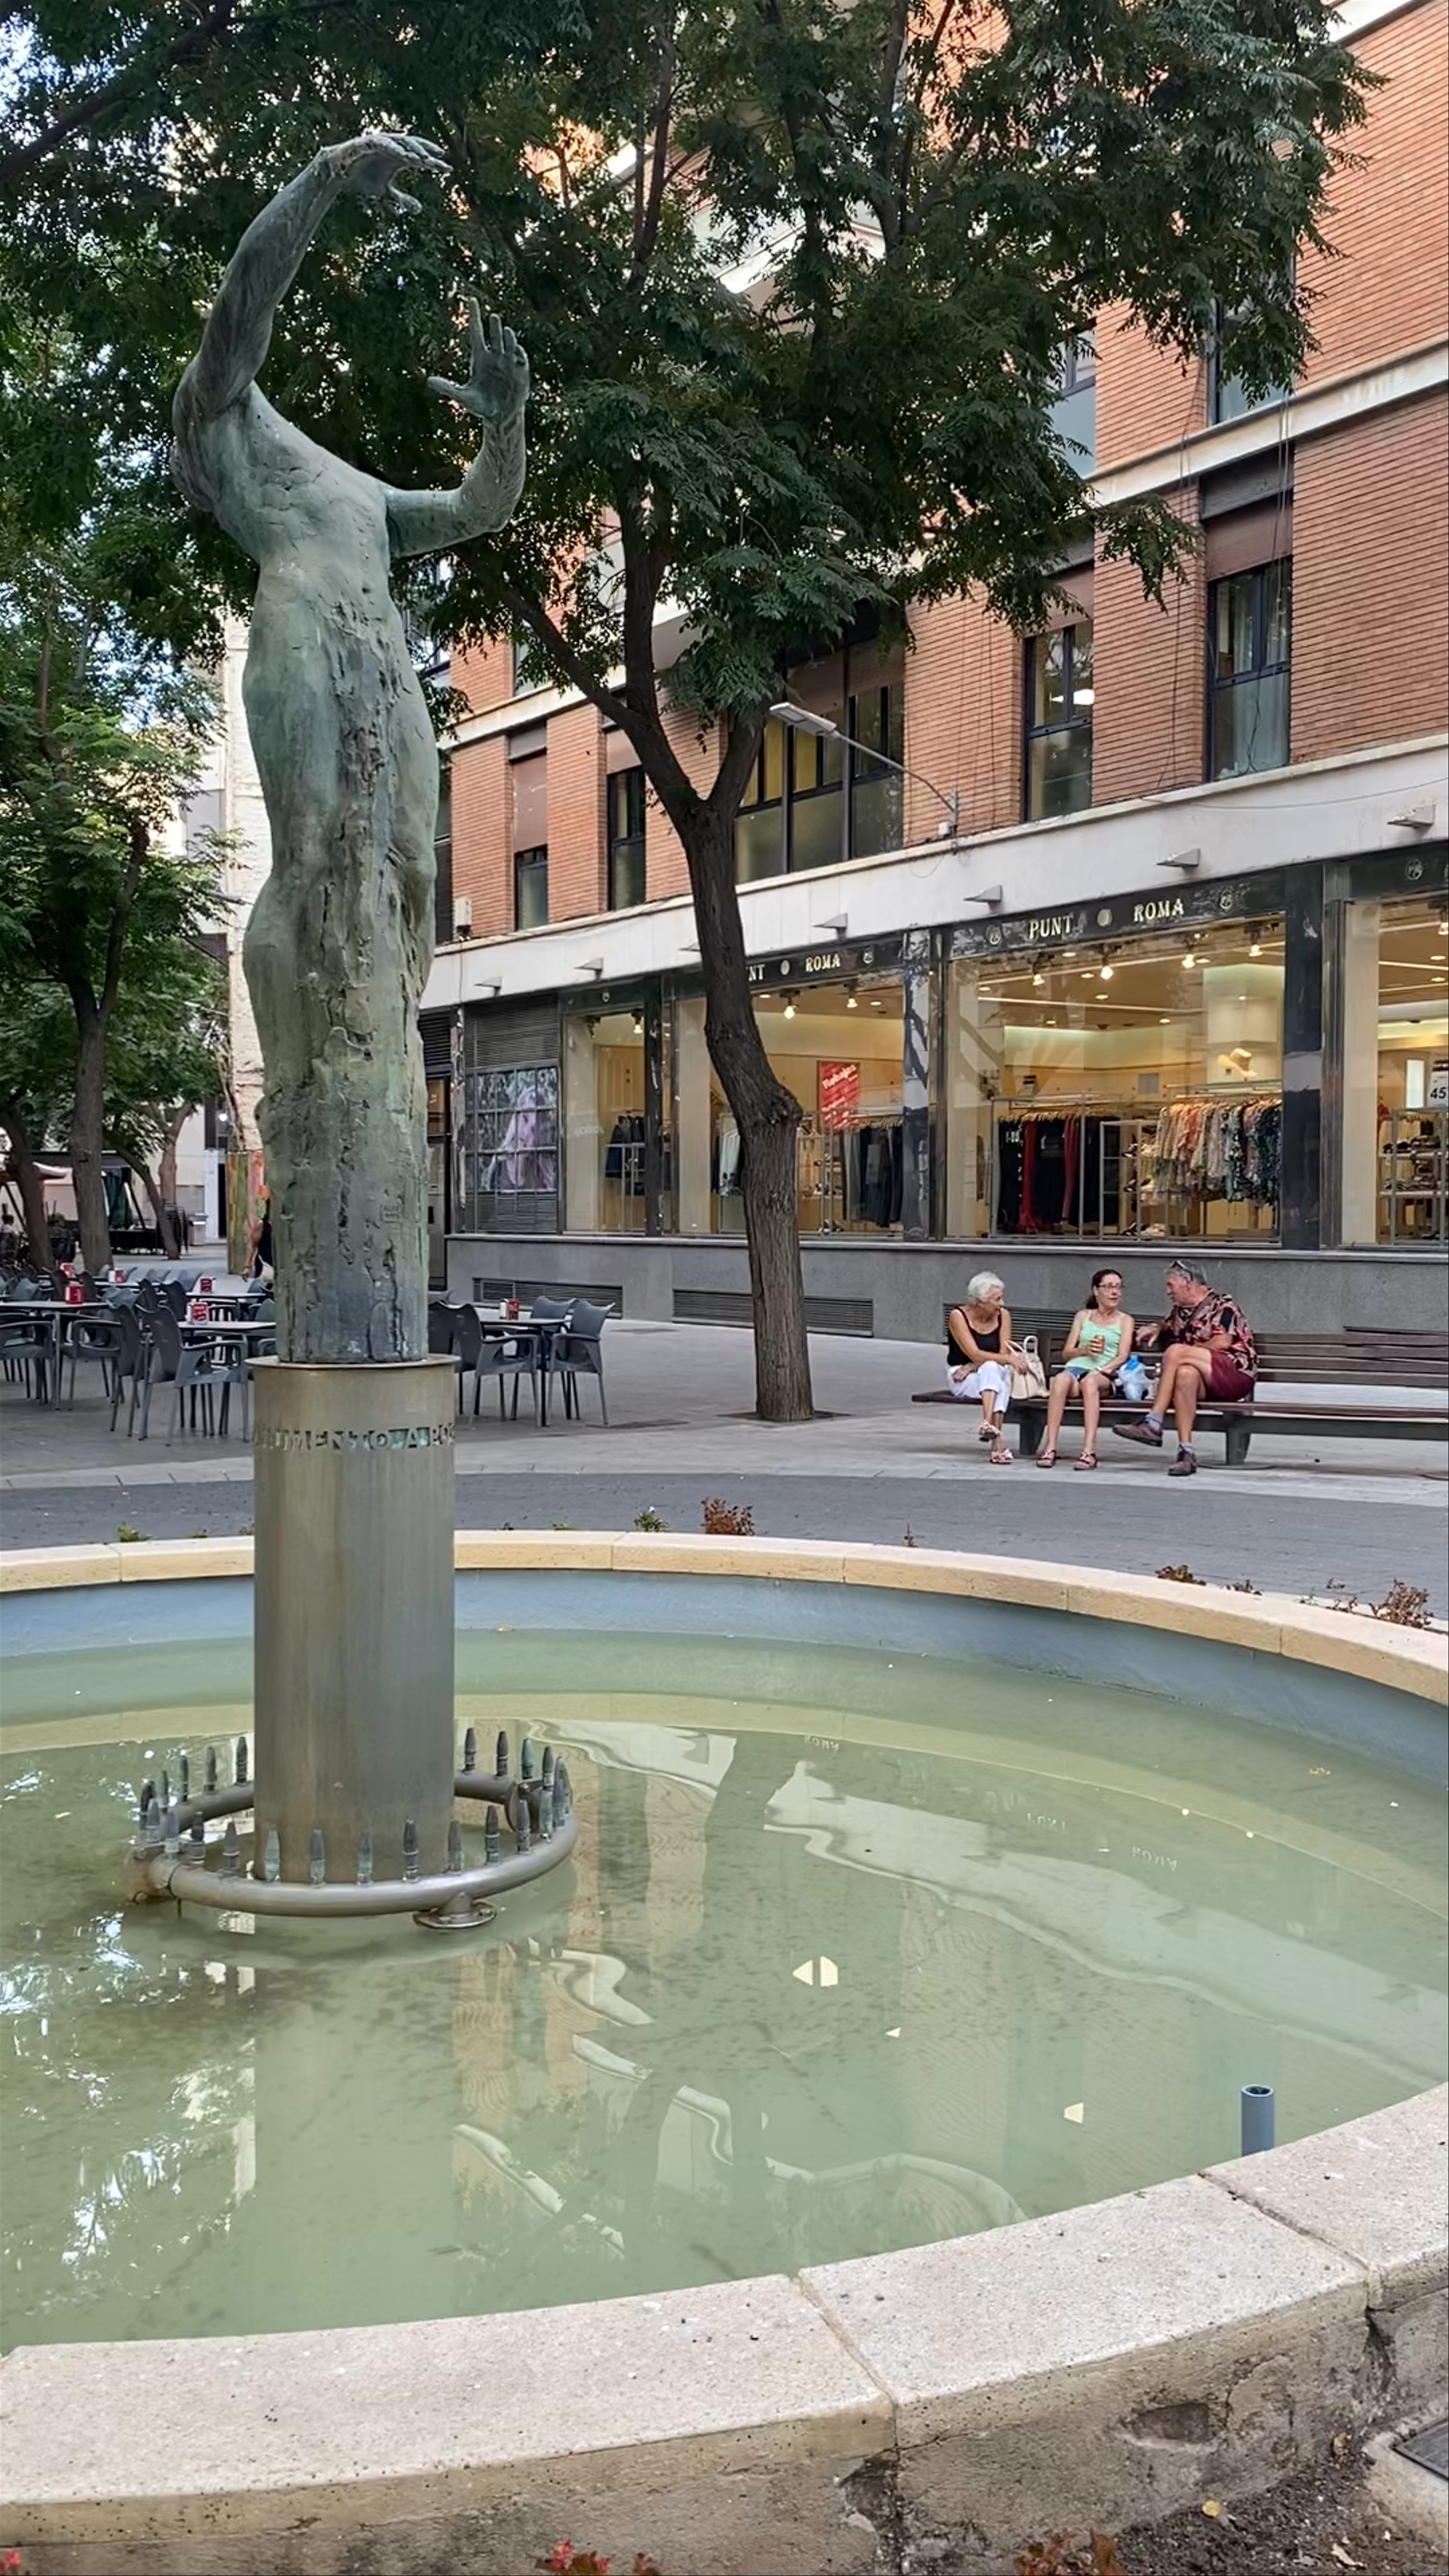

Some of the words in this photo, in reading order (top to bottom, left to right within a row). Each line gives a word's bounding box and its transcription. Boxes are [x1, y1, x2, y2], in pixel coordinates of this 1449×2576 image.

[1029, 914, 1074, 939] PUNT
[1134, 898, 1184, 922] ROMA
[805, 953, 841, 972] ROMA
